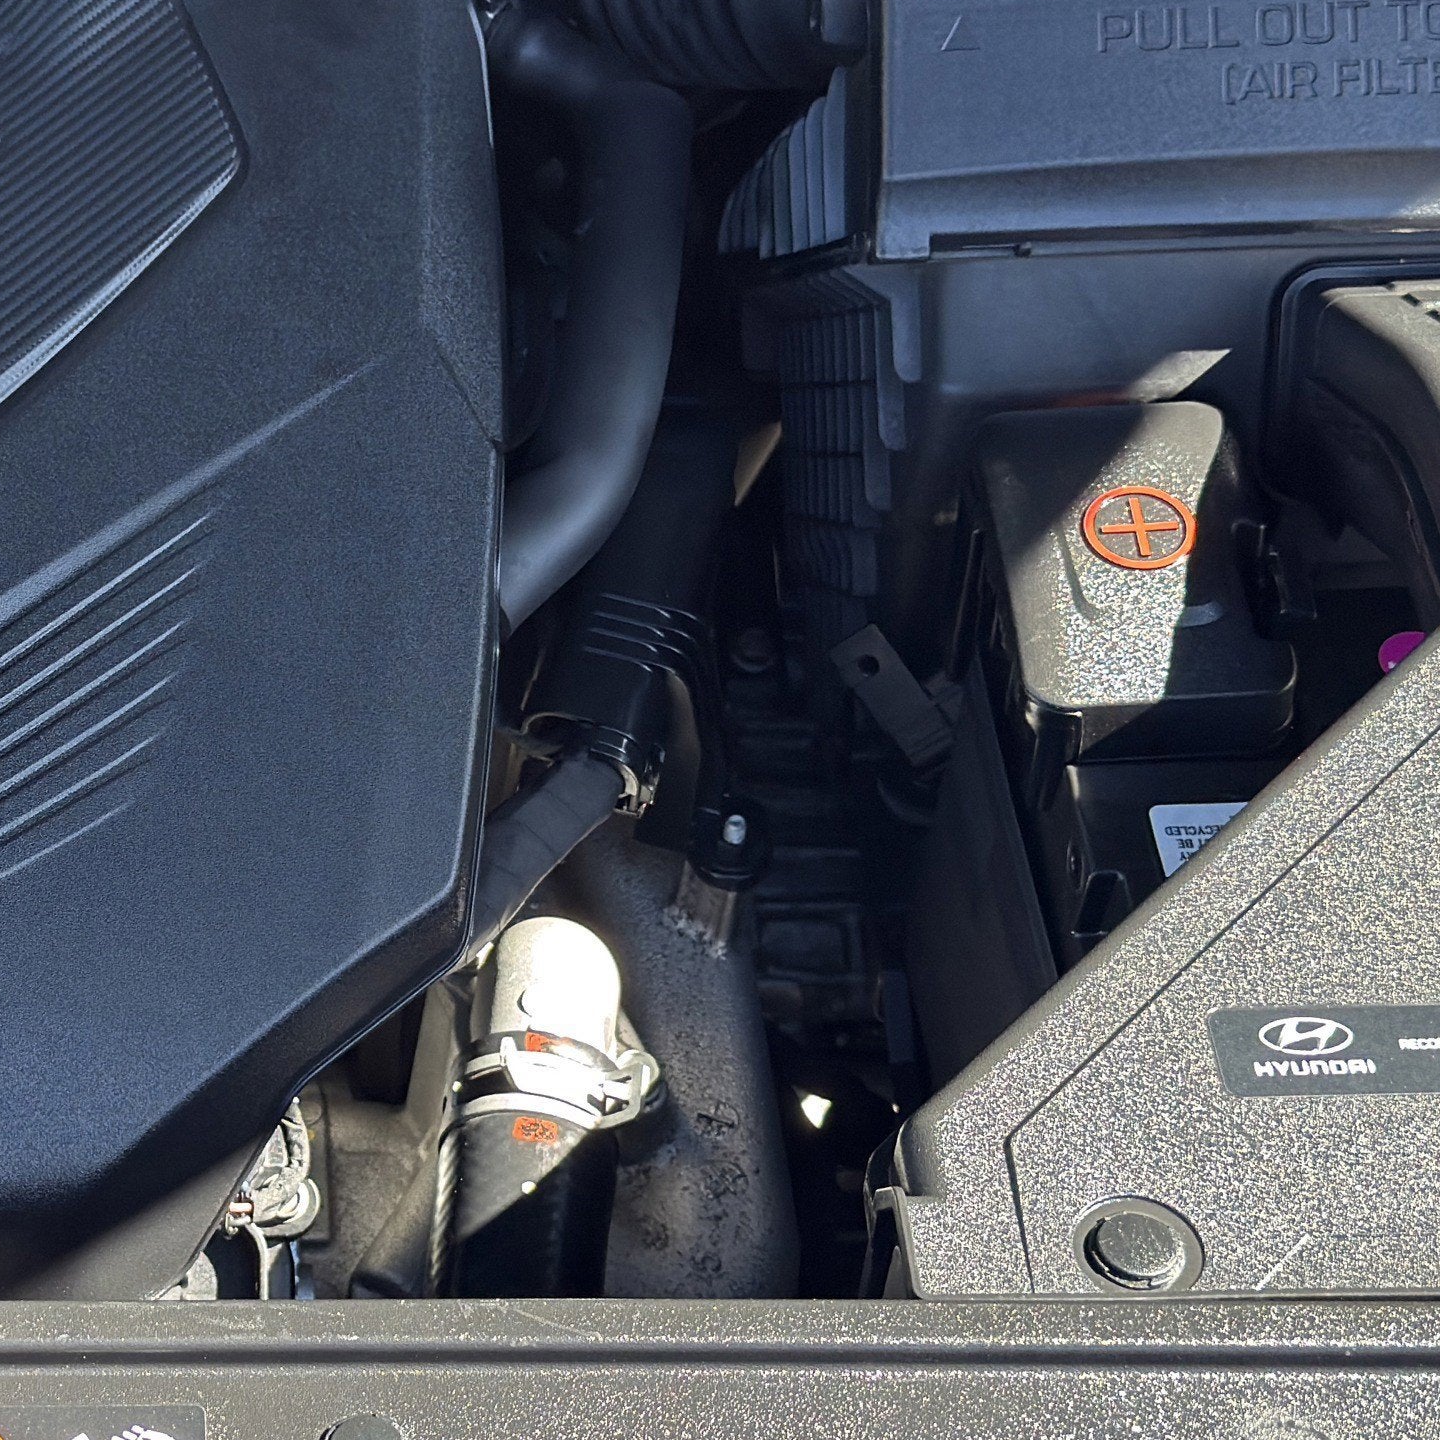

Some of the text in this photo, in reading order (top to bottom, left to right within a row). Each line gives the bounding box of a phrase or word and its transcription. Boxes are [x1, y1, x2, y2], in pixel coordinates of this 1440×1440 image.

[1095, 3, 1240, 53] PULL
[1254, 0, 1370, 47] OUT
[1224, 59, 1318, 105] (AIR
[1164, 825, 1225, 836] ECYCLED
[1253, 1059, 1377, 1078] HYUNDAI
